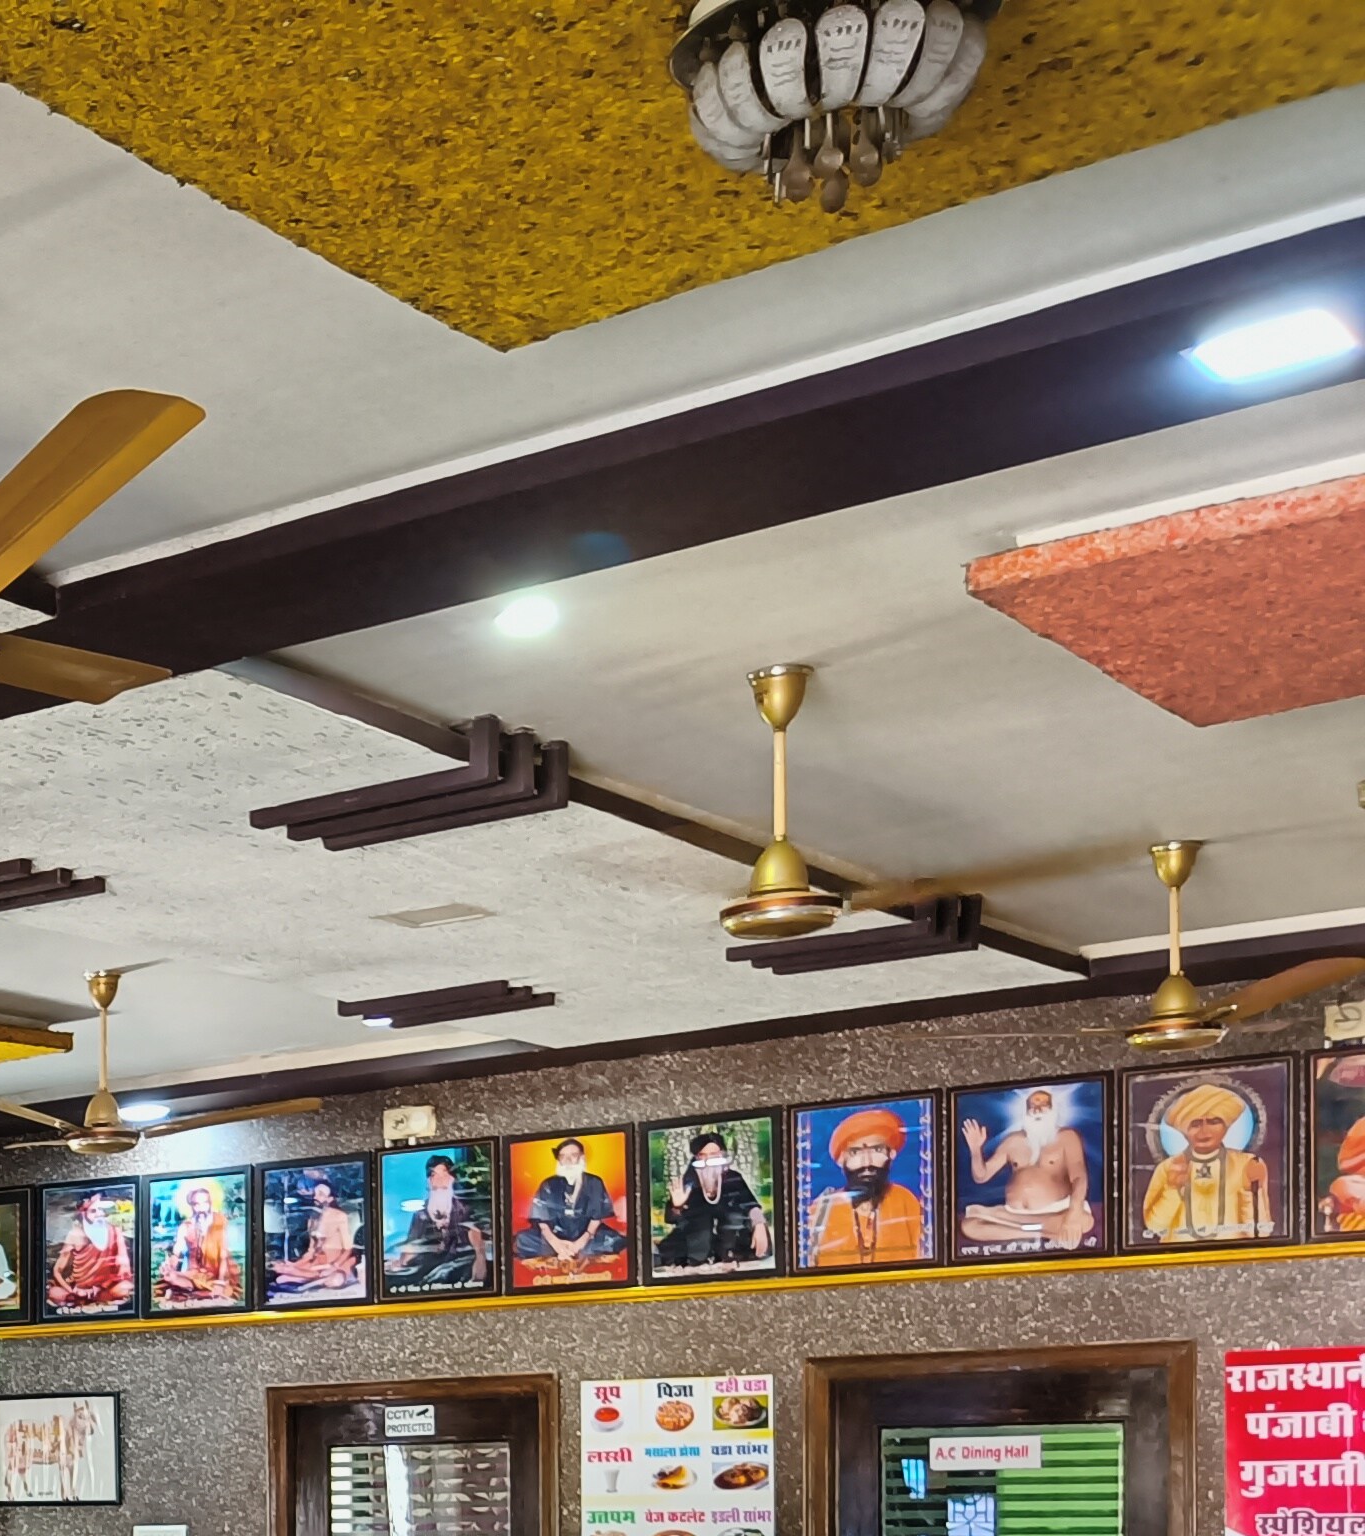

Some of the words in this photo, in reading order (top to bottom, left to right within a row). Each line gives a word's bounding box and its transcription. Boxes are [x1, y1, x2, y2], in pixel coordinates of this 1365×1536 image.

[715, 1378, 739, 1393] दही
[594, 1385, 621, 1404] सूप
[386, 1409, 414, 1420] CCTV
[1245, 1402, 1357, 1439] पंजाबी
[386, 1423, 432, 1433] PROTECTED
[587, 1447, 633, 1463] लस्सी
[645, 1447, 676, 1457] मसाला
[736, 1441, 768, 1455] सांभर
[935, 1447, 956, 1460] A.C
[962, 1446, 1001, 1463] Dining
[1005, 1445, 1028, 1459] Hall
[1239, 1450, 1365, 1498] गुजराती
[586, 1510, 635, 1524] उत्तपम
[668, 1508, 705, 1523] कटलेट
[711, 1507, 740, 1523] इडली
[743, 1507, 771, 1522] सांभर
